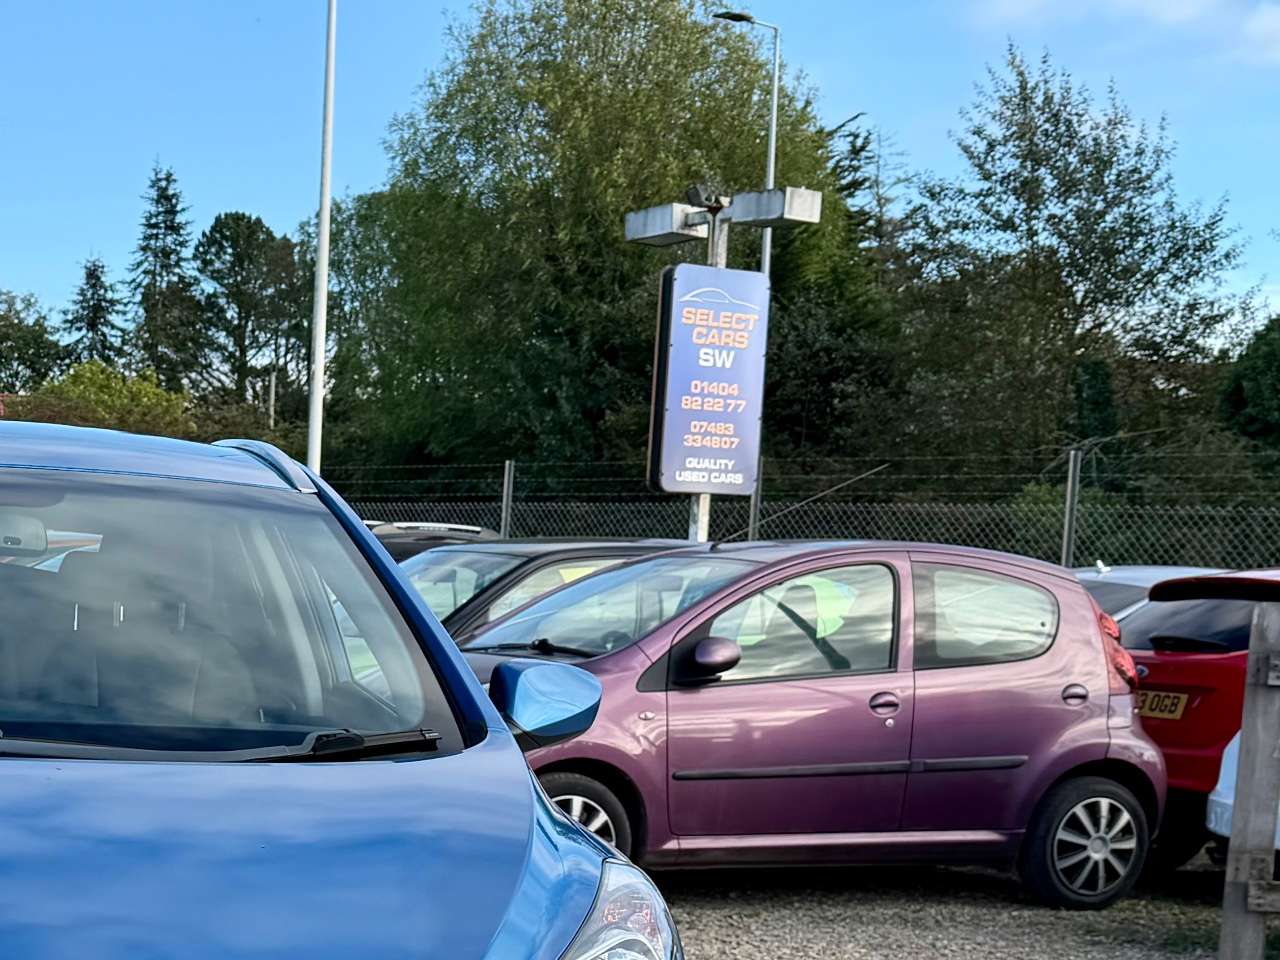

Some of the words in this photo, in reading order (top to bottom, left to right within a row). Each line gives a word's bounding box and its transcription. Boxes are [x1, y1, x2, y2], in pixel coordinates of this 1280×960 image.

[681, 307, 759, 330] SELECT
[692, 327, 749, 349] CARS
[698, 347, 735, 369] SW
[691, 380, 739, 396] 01404
[690, 421, 734, 435] 07483
[685, 457, 735, 470] QUALITY
[675, 470, 709, 482] USED
[710, 472, 744, 484] CARS
